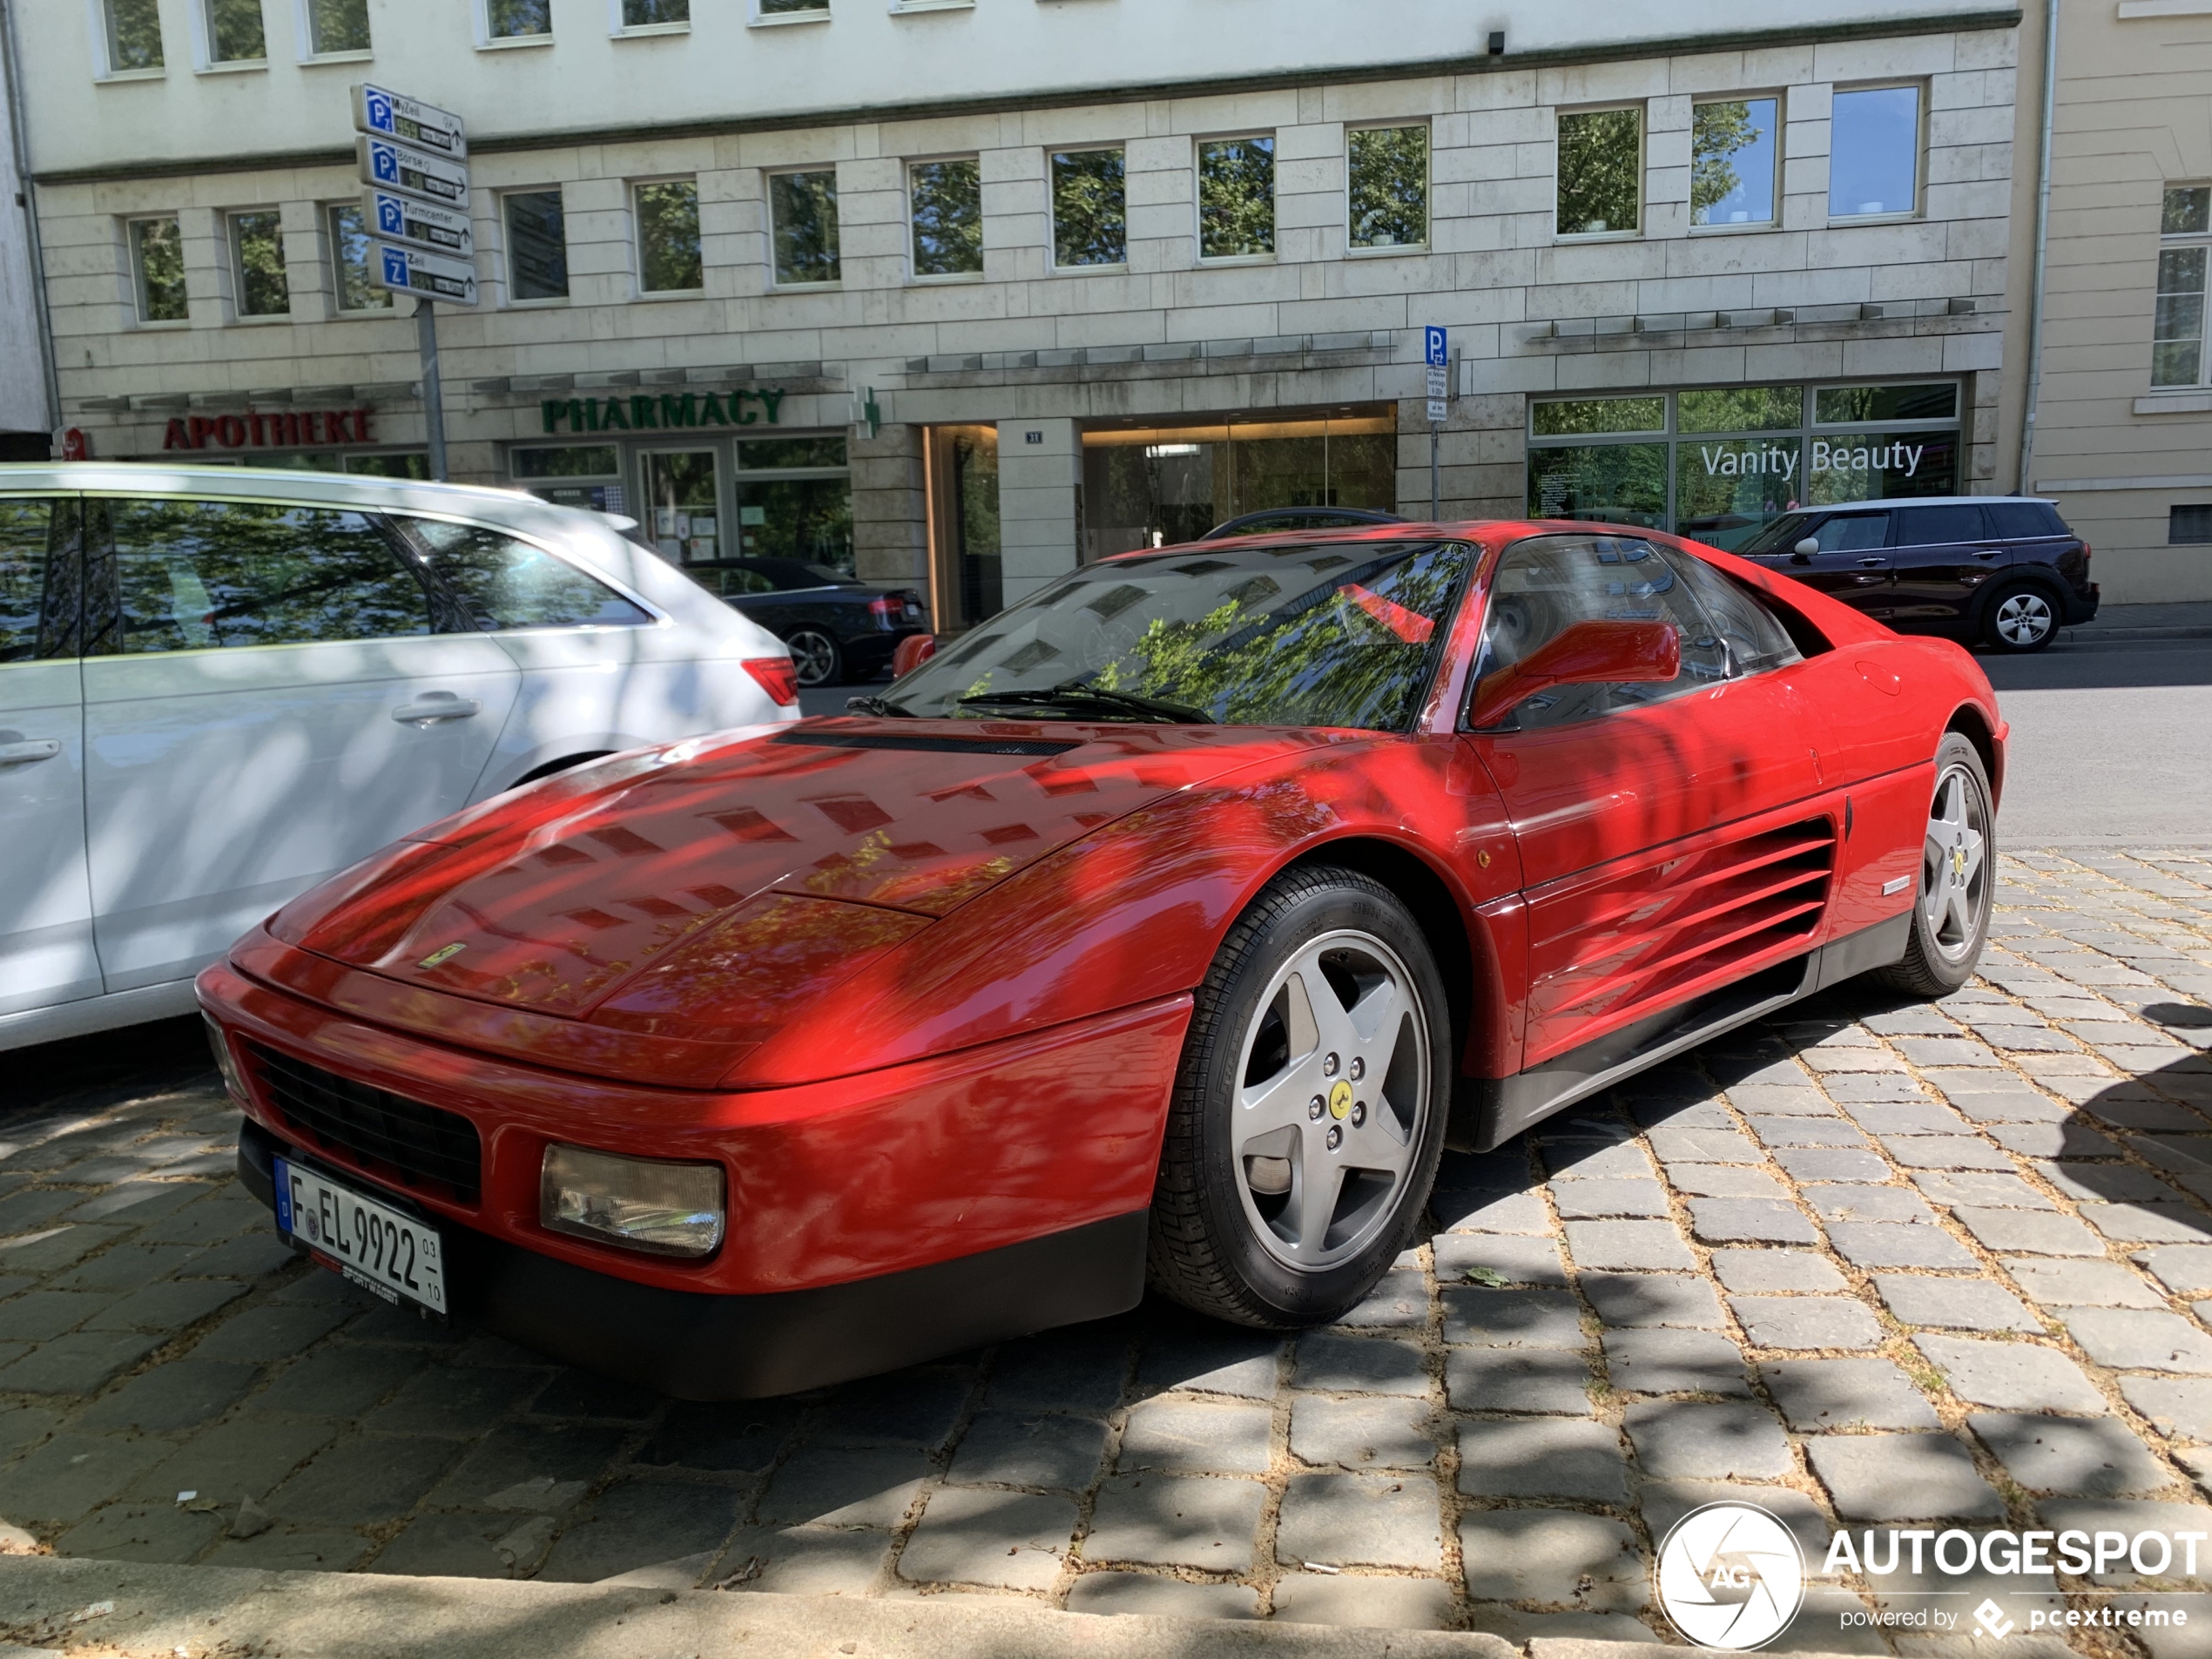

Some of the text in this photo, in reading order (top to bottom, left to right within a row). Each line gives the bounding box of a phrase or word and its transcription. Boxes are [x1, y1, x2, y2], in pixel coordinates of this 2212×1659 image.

[391, 97, 420, 117] MyZeil
[402, 202, 452, 224] Turmcenter
[407, 253, 424, 267] Zeil
[1430, 331, 1442, 361] P
[541, 388, 784, 433] PHARMACY
[163, 408, 378, 449] APOTHEKE
[1028, 432, 1040, 442] 31
[1701, 441, 1924, 481] Vanity Beauty
[290, 1175, 419, 1291] F EL 9922
[422, 1238, 436, 1258] 03
[342, 1265, 398, 1306] SPORTWAGEN
[428, 1281, 441, 1302] 10
